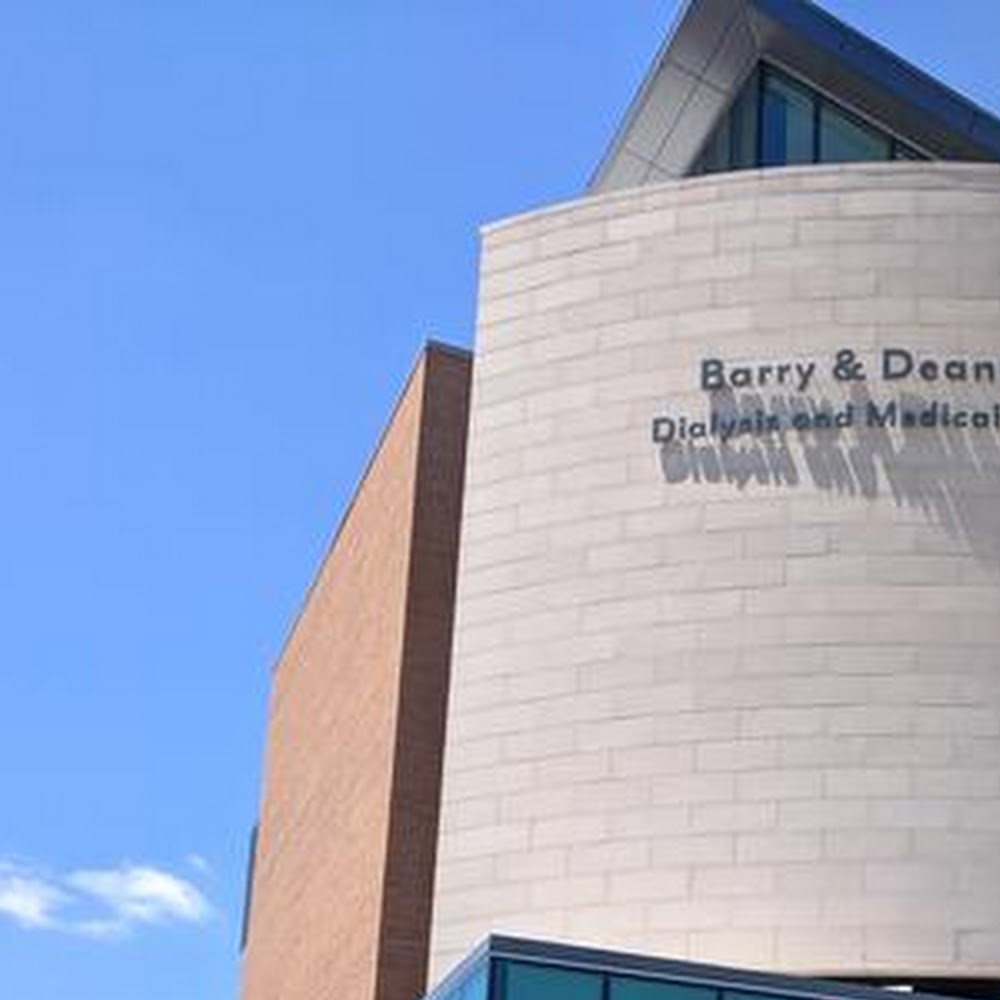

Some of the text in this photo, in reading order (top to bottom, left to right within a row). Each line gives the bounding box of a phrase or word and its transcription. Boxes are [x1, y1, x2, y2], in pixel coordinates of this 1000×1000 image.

[702, 359, 815, 391] Barry
[832, 349, 867, 381] &
[652, 408, 781, 444] Dialysis
[791, 401, 854, 430] and
[866, 400, 1000, 429] Medical
